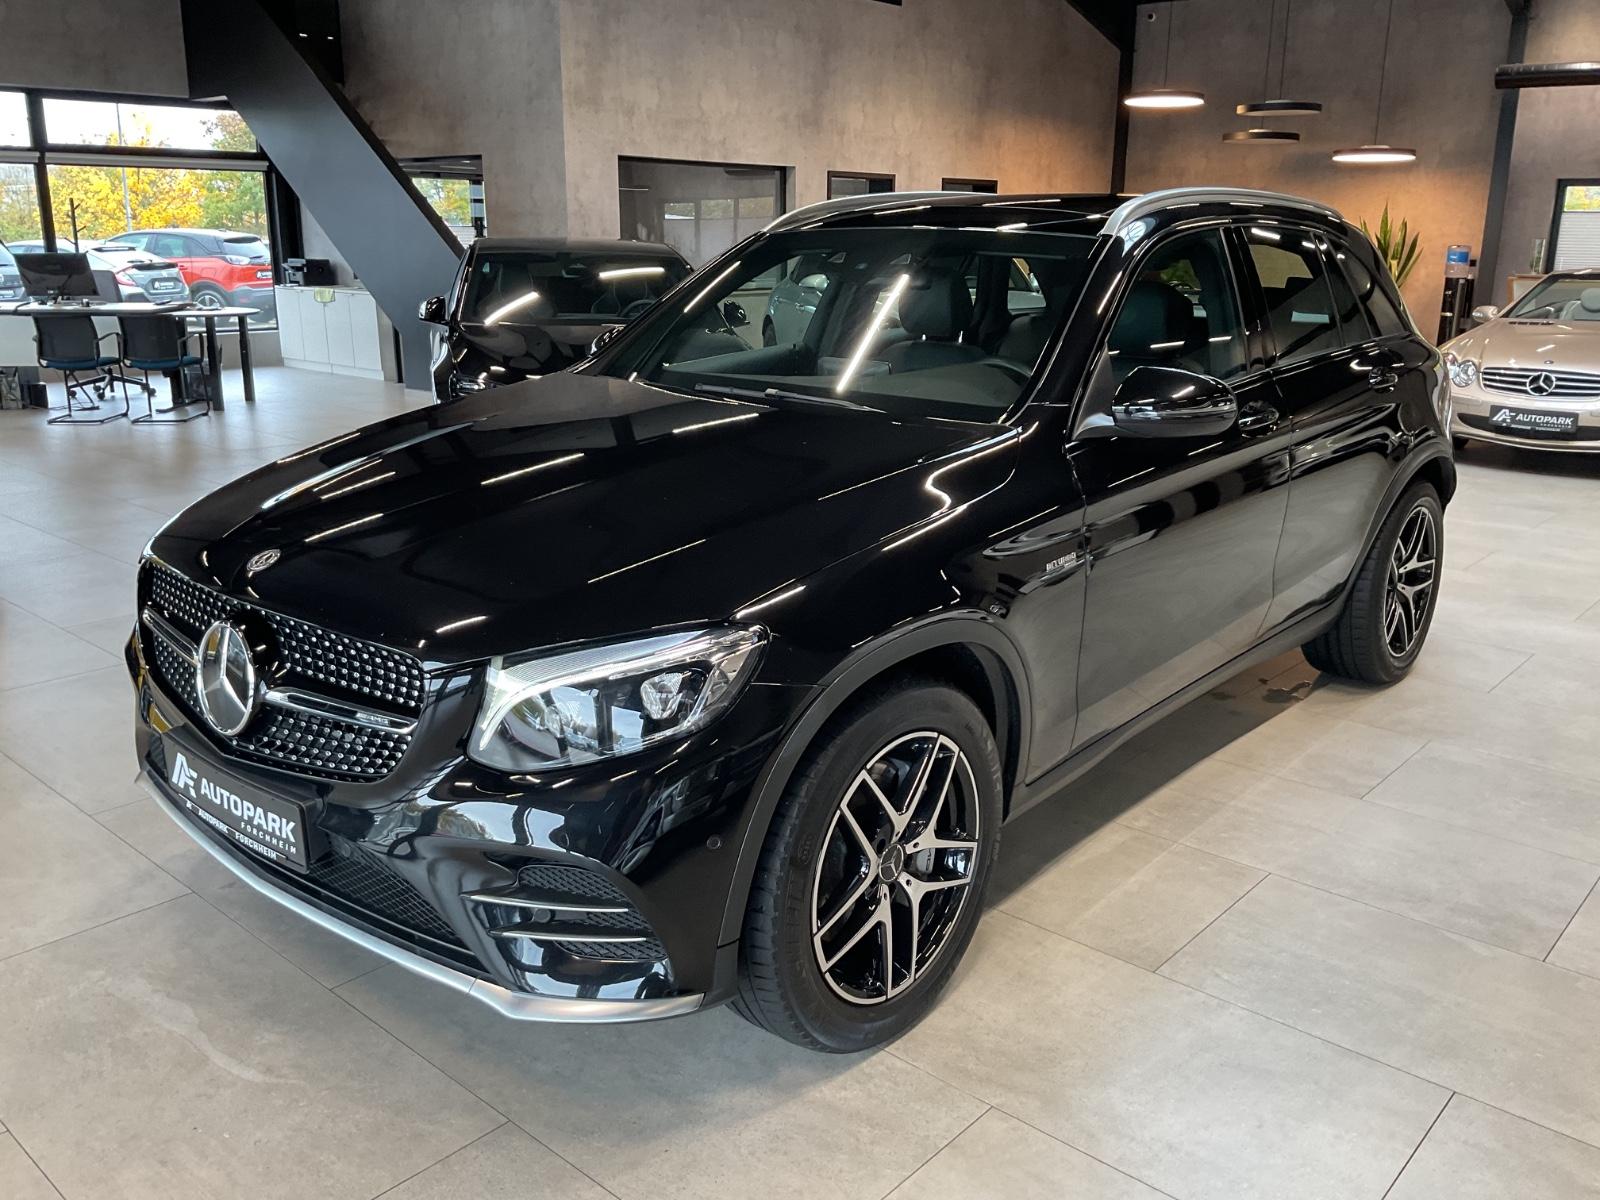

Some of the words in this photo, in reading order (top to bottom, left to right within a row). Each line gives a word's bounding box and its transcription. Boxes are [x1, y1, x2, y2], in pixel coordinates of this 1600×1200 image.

[1516, 413, 1574, 425] AUTOPARK
[200, 777, 296, 843] AUTOPARK
[235, 831, 277, 860] FORCHHEIM
[240, 821, 297, 854] FORCHHEIM
